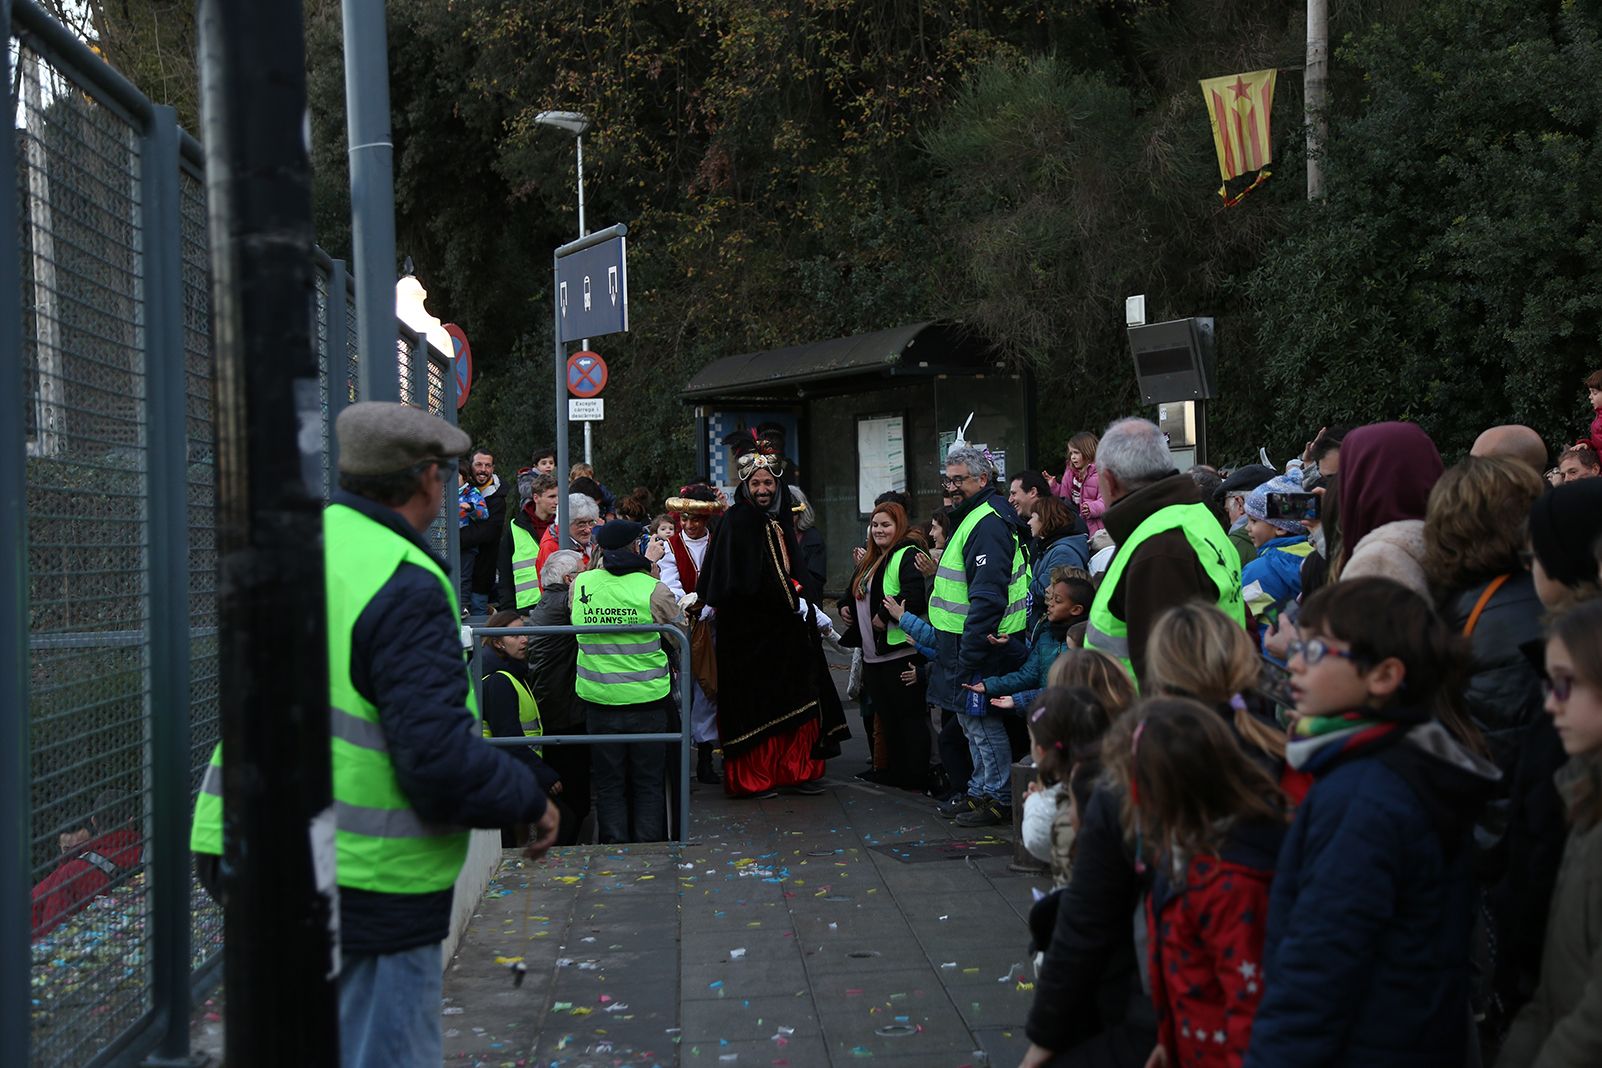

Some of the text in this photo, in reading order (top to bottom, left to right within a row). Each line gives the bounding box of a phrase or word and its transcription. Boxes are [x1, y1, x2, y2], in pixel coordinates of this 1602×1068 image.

[583, 607, 638, 616] LA FLORESTA
[583, 616, 598, 624] 100
[599, 616, 623, 624] ANYS
